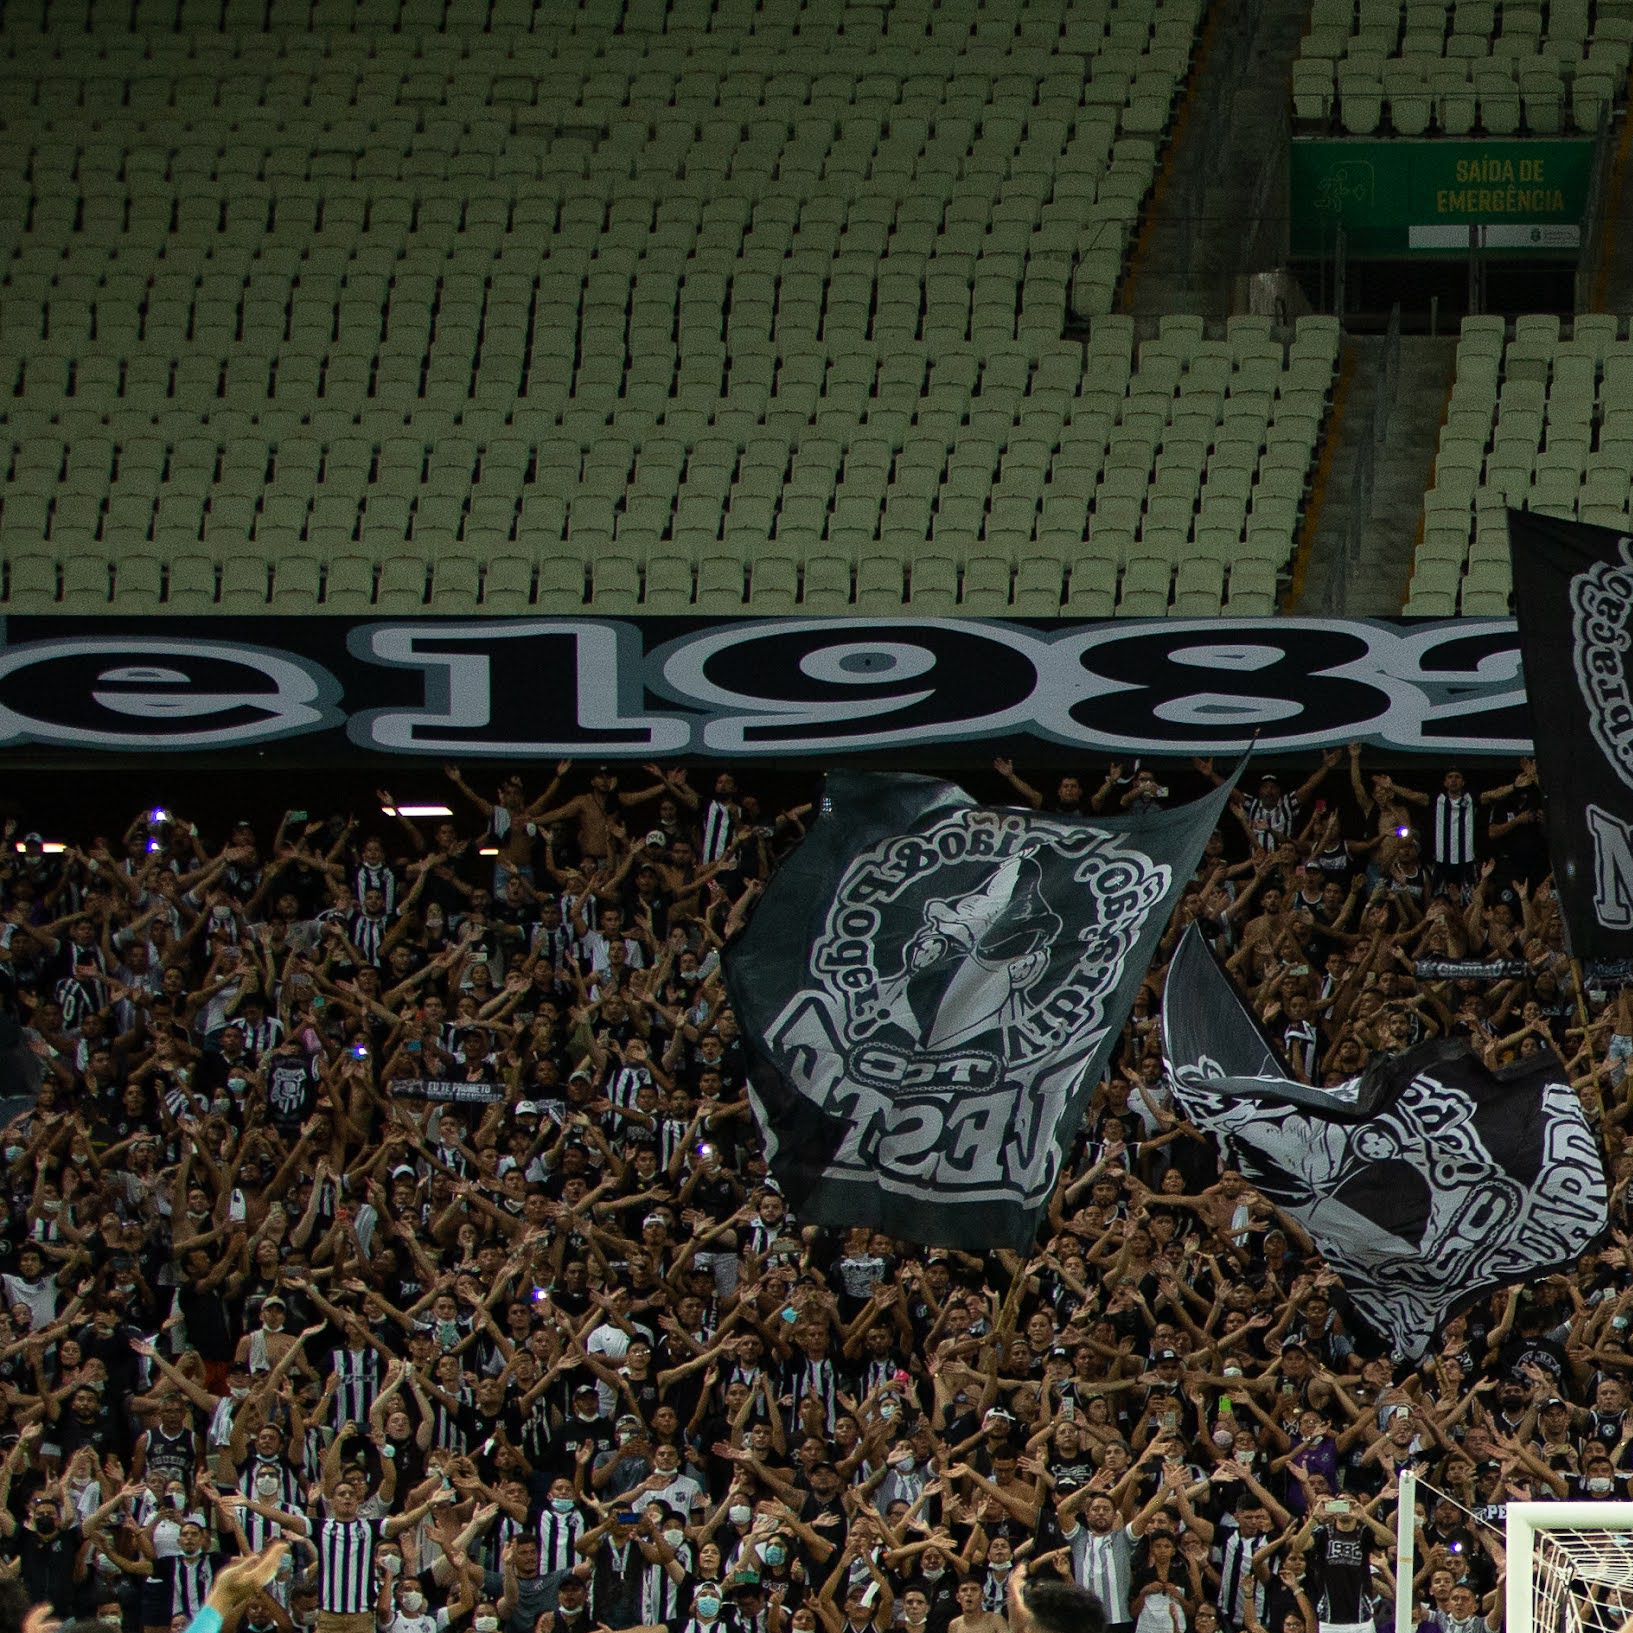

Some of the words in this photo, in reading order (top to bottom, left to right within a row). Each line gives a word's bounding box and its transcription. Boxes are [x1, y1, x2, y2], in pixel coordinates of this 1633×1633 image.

[1456, 154, 1514, 184] SAÍDA
[1520, 160, 1544, 182] DE
[1436, 184, 1565, 213] EMERGÊNCIA
[1486, 1505, 1506, 1520] PE
